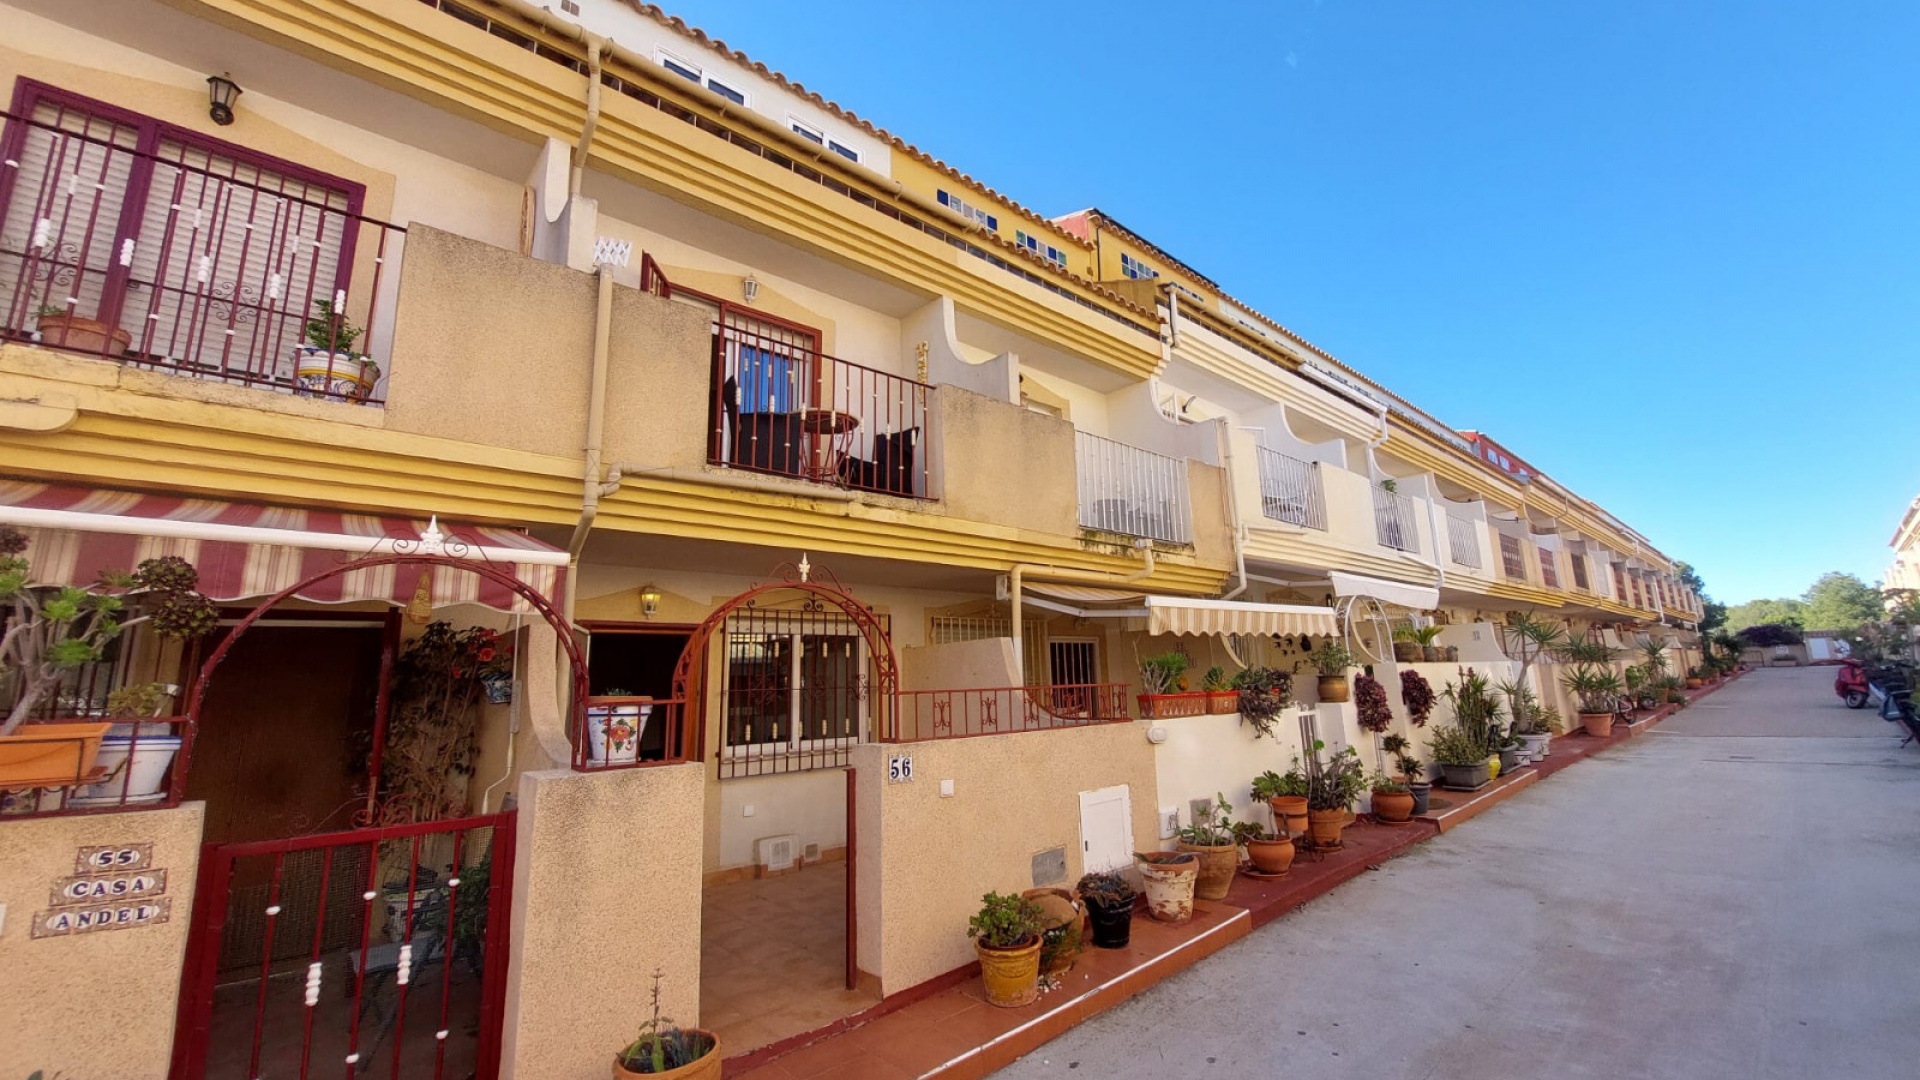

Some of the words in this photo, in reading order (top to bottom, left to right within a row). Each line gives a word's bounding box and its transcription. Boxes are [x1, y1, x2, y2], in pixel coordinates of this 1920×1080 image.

[890, 758, 911, 779] 56
[97, 851, 132, 865] 55
[72, 878, 144, 896] CASA
[55, 907, 150, 929] ANDEL
